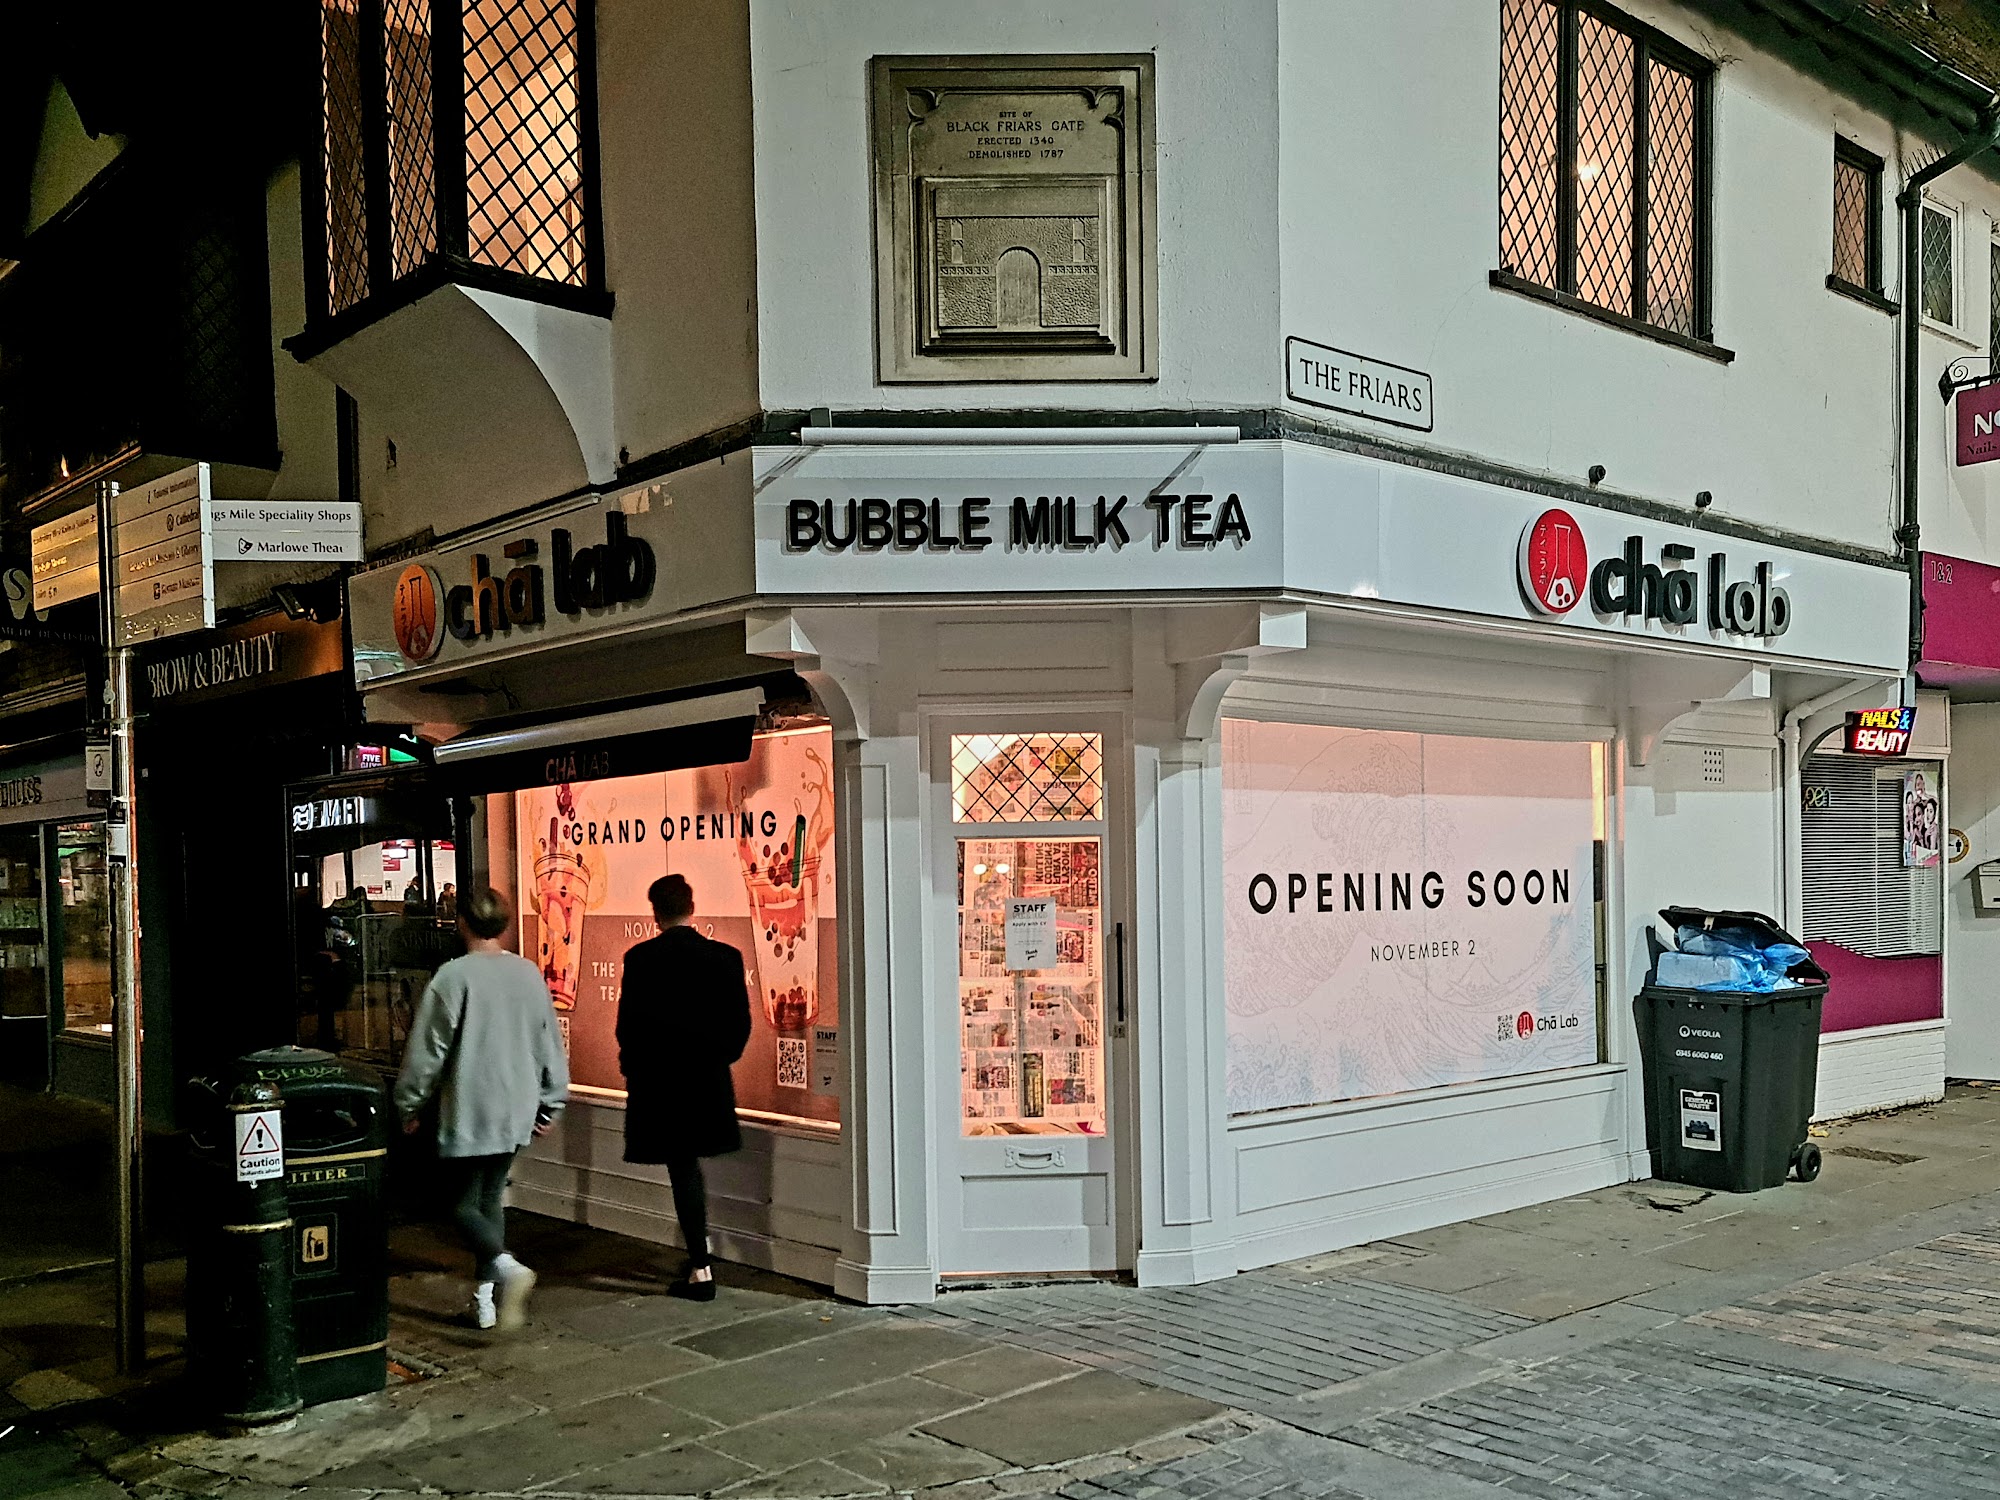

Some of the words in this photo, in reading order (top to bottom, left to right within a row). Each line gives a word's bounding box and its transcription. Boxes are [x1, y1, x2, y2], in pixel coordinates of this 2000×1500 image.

[947, 120, 990, 132] BLACK
[997, 120, 1042, 132] FRIARS
[1051, 120, 1085, 132] GATE
[977, 137, 1022, 146] ERECTED
[1029, 136, 1055, 145] 1340
[969, 150, 1032, 159] DEMOLISHED
[1040, 150, 1064, 159] 1787
[1299, 357, 1342, 393] THE
[1348, 371, 1422, 412] FRIARS
[1966, 439, 1998, 456] Nails
[229, 509, 255, 519] Mile
[259, 509, 314, 523] Speciality
[318, 510, 352, 523] Shops
[787, 496, 993, 550] BUBBLE
[1011, 494, 1131, 549] MILK
[1147, 493, 1252, 548] TEA
[257, 541, 309, 553] Marlowe
[551, 510, 657, 615] lab
[1930, 560, 1953, 584] 1&2
[1707, 552, 1792, 637] lab
[147, 655, 190, 698] BROW
[194, 651, 209, 689] &
[211, 630, 277, 684] BEAUTY
[1859, 709, 1900, 729] NAILS
[1855, 729, 1908, 753] BEAUTY
[362, 753, 381, 763] FIVE
[571, 818, 646, 846] GRAND
[660, 810, 777, 843] OPENING
[1248, 871, 1445, 915] OPENING
[1467, 868, 1570, 908] SOON
[1013, 903, 1047, 913] STAFF
[706, 923, 715, 940] 2
[1371, 940, 1460, 962] NOVEMBER
[1468, 939, 1476, 955] 2
[592, 961, 616, 979] THE
[1560, 1014, 1579, 1029] Lab
[816, 1031, 837, 1040] STAFF
[1691, 1029, 1721, 1038] VEOLIA
[240, 1157, 280, 1169] Caution
[287, 1167, 348, 1184] ITTER
